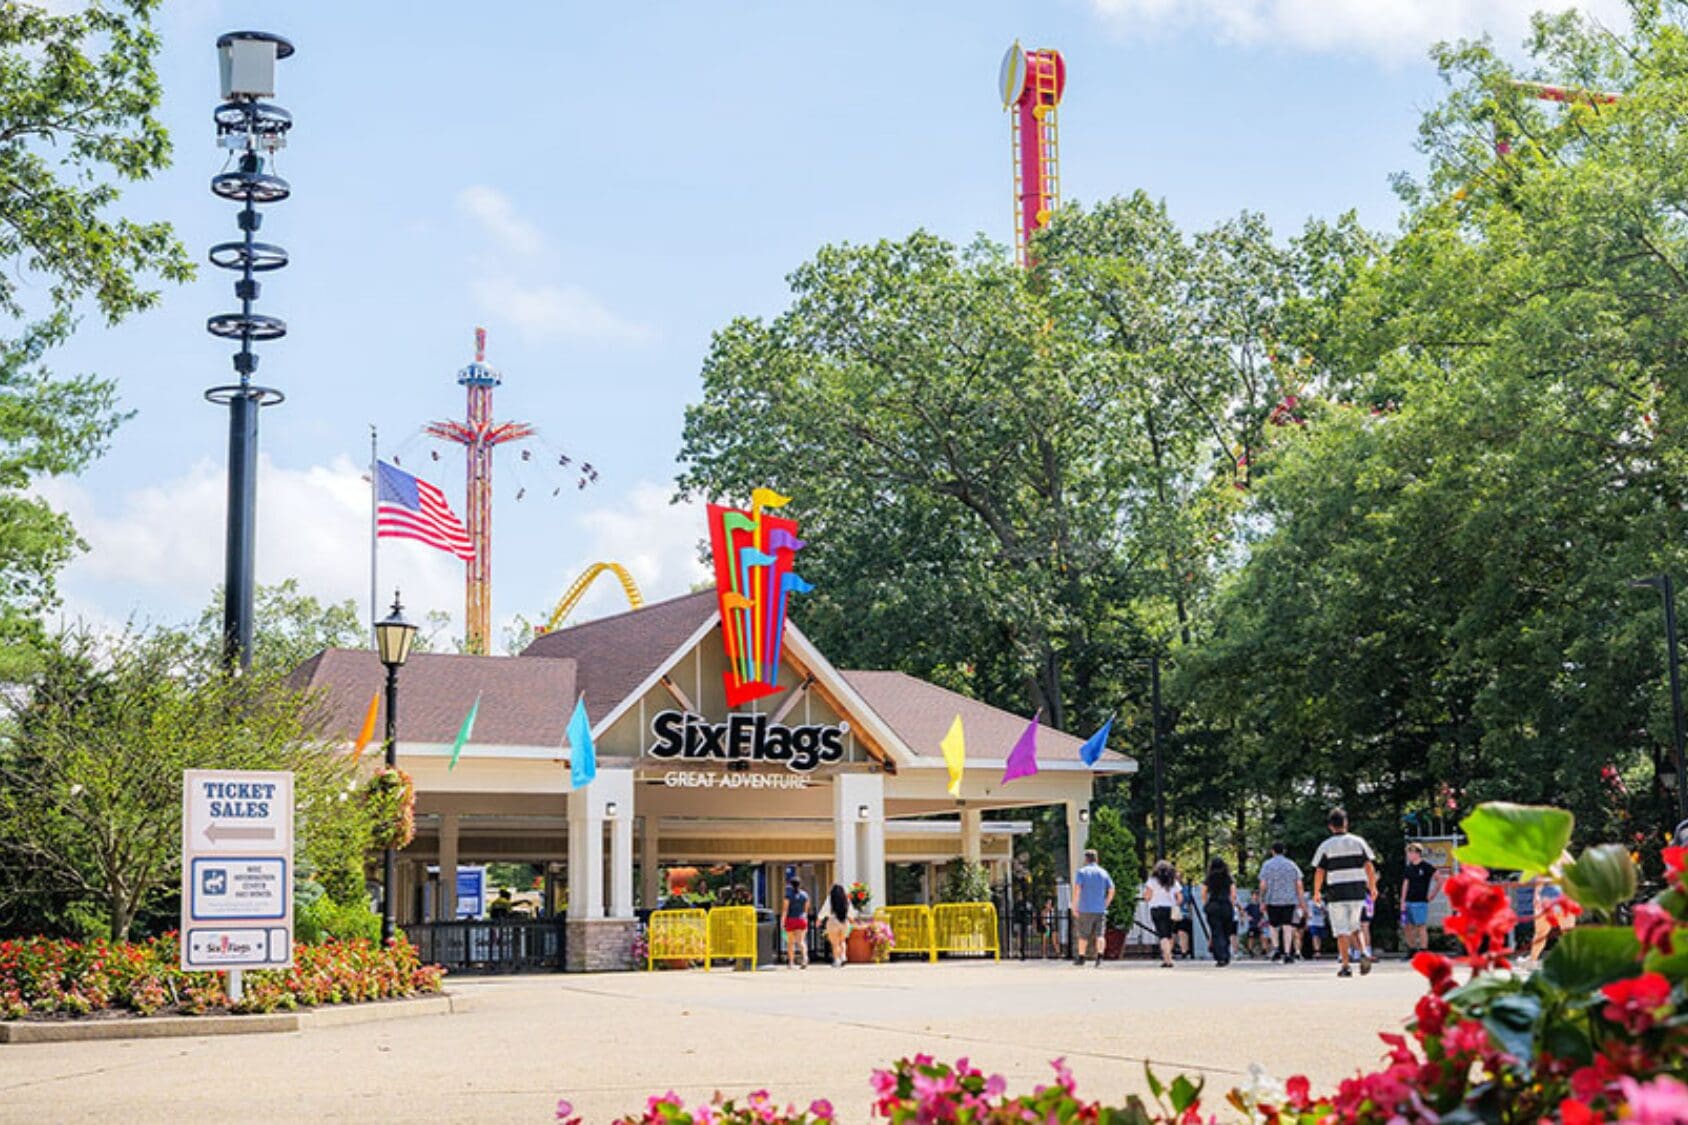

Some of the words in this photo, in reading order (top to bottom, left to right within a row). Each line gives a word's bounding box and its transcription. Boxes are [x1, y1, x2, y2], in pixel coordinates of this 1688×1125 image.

[664, 771, 716, 788] GREAT
[719, 773, 808, 789] ADVENTURE
[203, 782, 276, 799] TICKET
[209, 801, 269, 818] SALES
